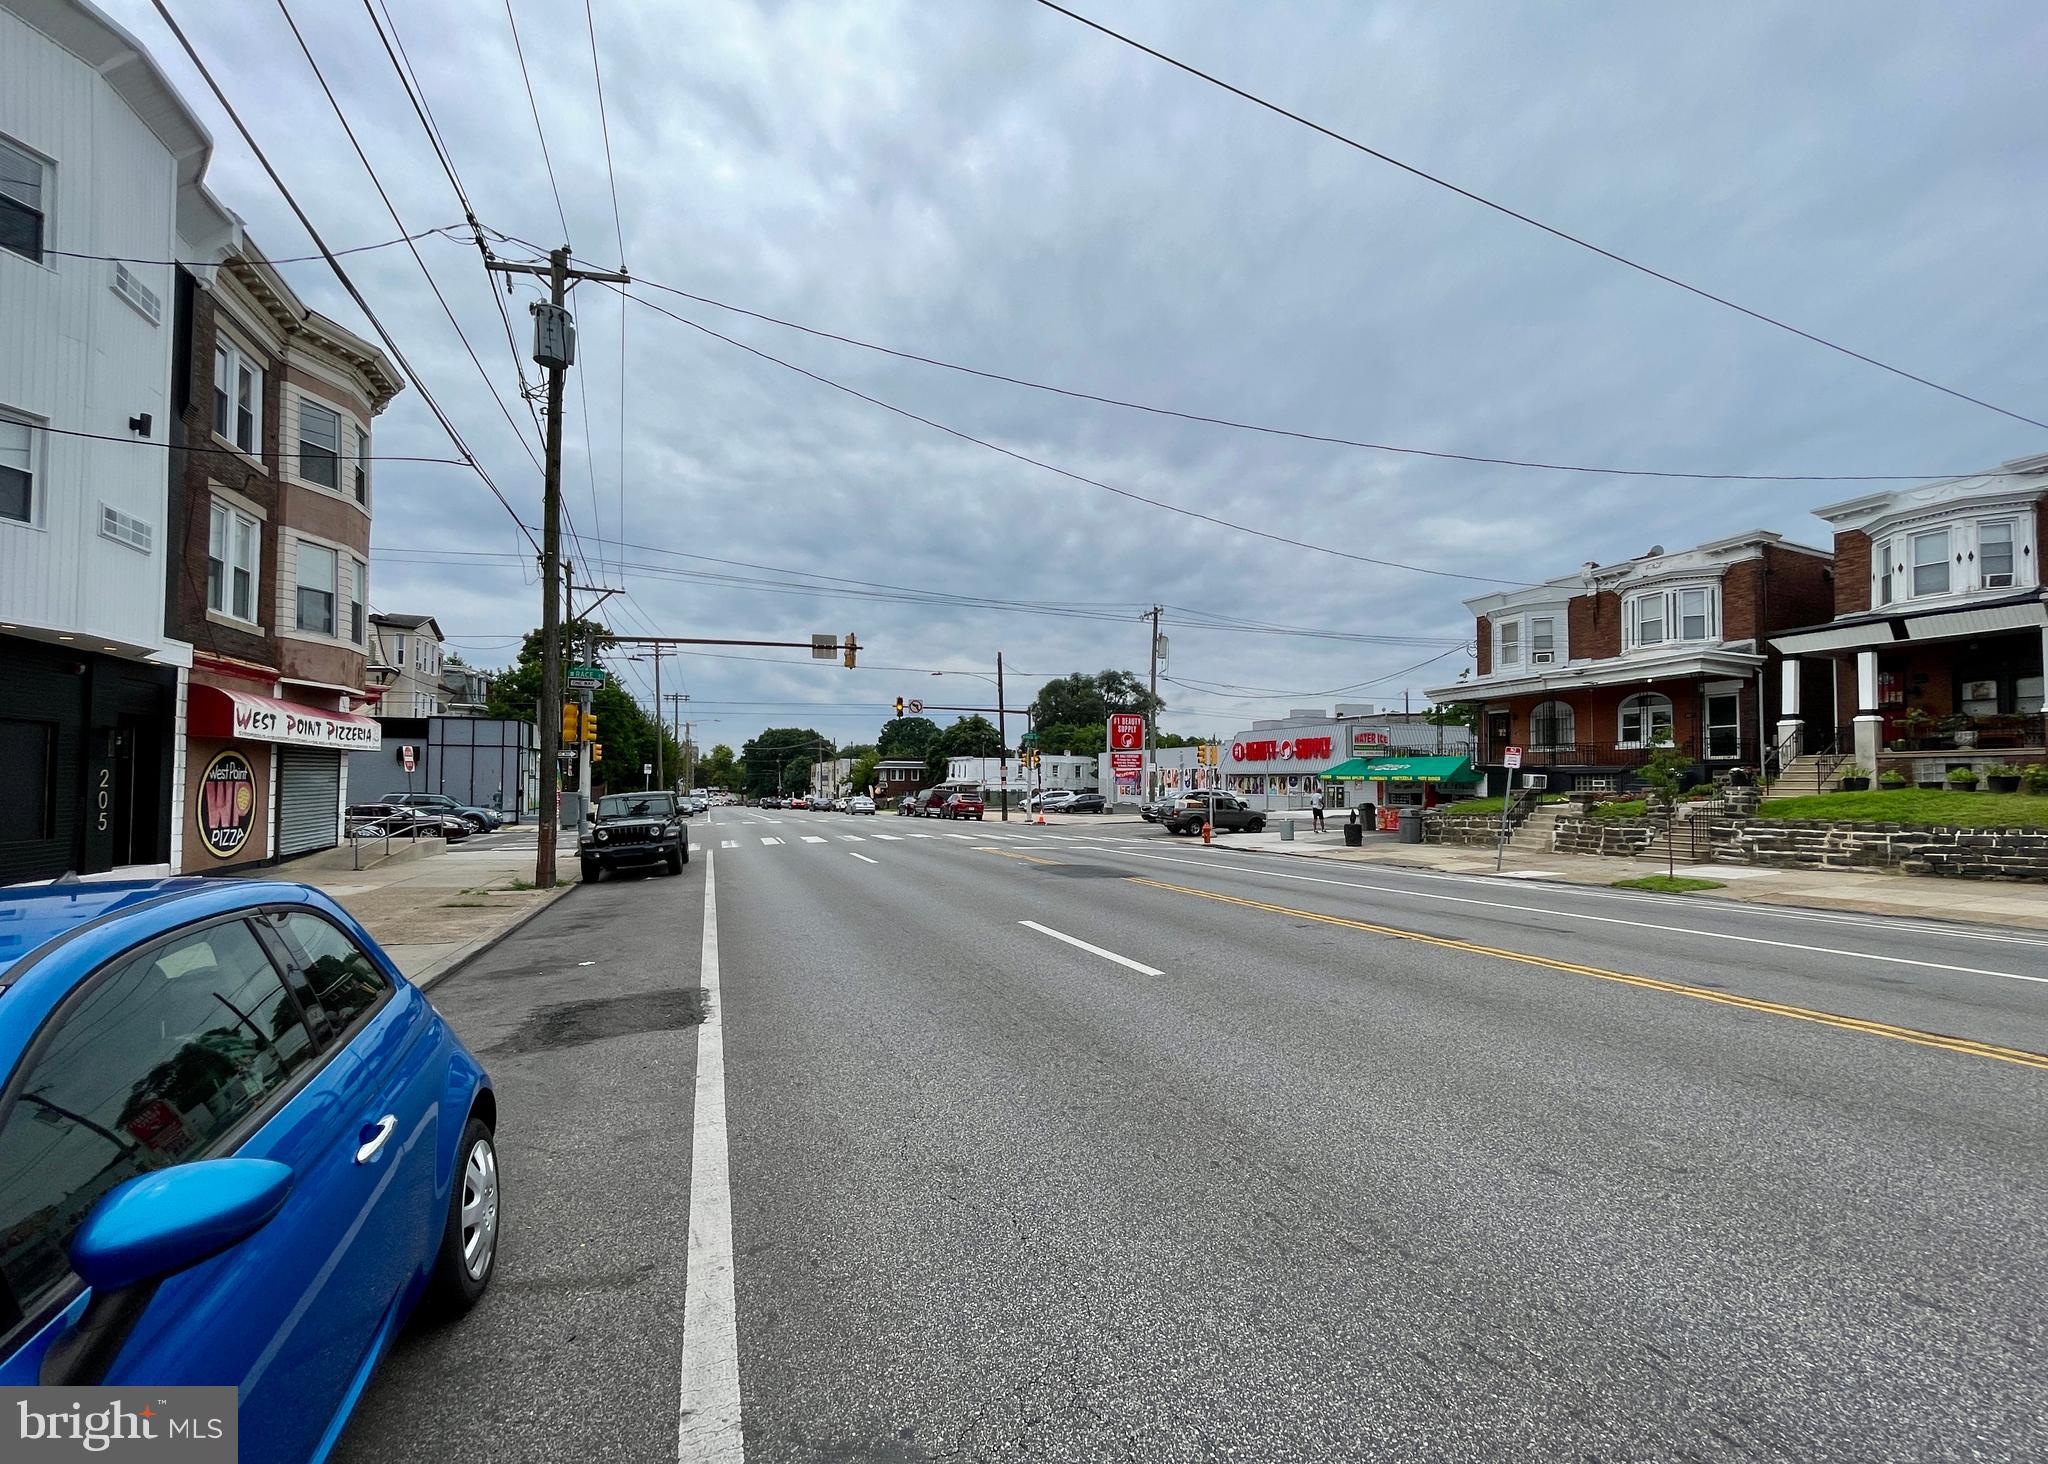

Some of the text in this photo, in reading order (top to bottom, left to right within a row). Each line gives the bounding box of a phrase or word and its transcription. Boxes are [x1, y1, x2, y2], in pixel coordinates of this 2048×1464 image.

[236, 707, 277, 731] WEST
[286, 714, 322, 737] POINT
[326, 721, 372, 743] PIZZERIA
[1116, 725, 1137, 733] SUPPLY
[1122, 717, 1141, 726] BEAUTY
[1354, 733, 1388, 744] WATER ICE
[1234, 737, 1331, 761] #1 BEAUTY SUPPLY
[209, 761, 248, 780] West Point
[97, 769, 110, 832] 205
[205, 780, 253, 829] WP
[210, 828, 245, 847] PIZZA
